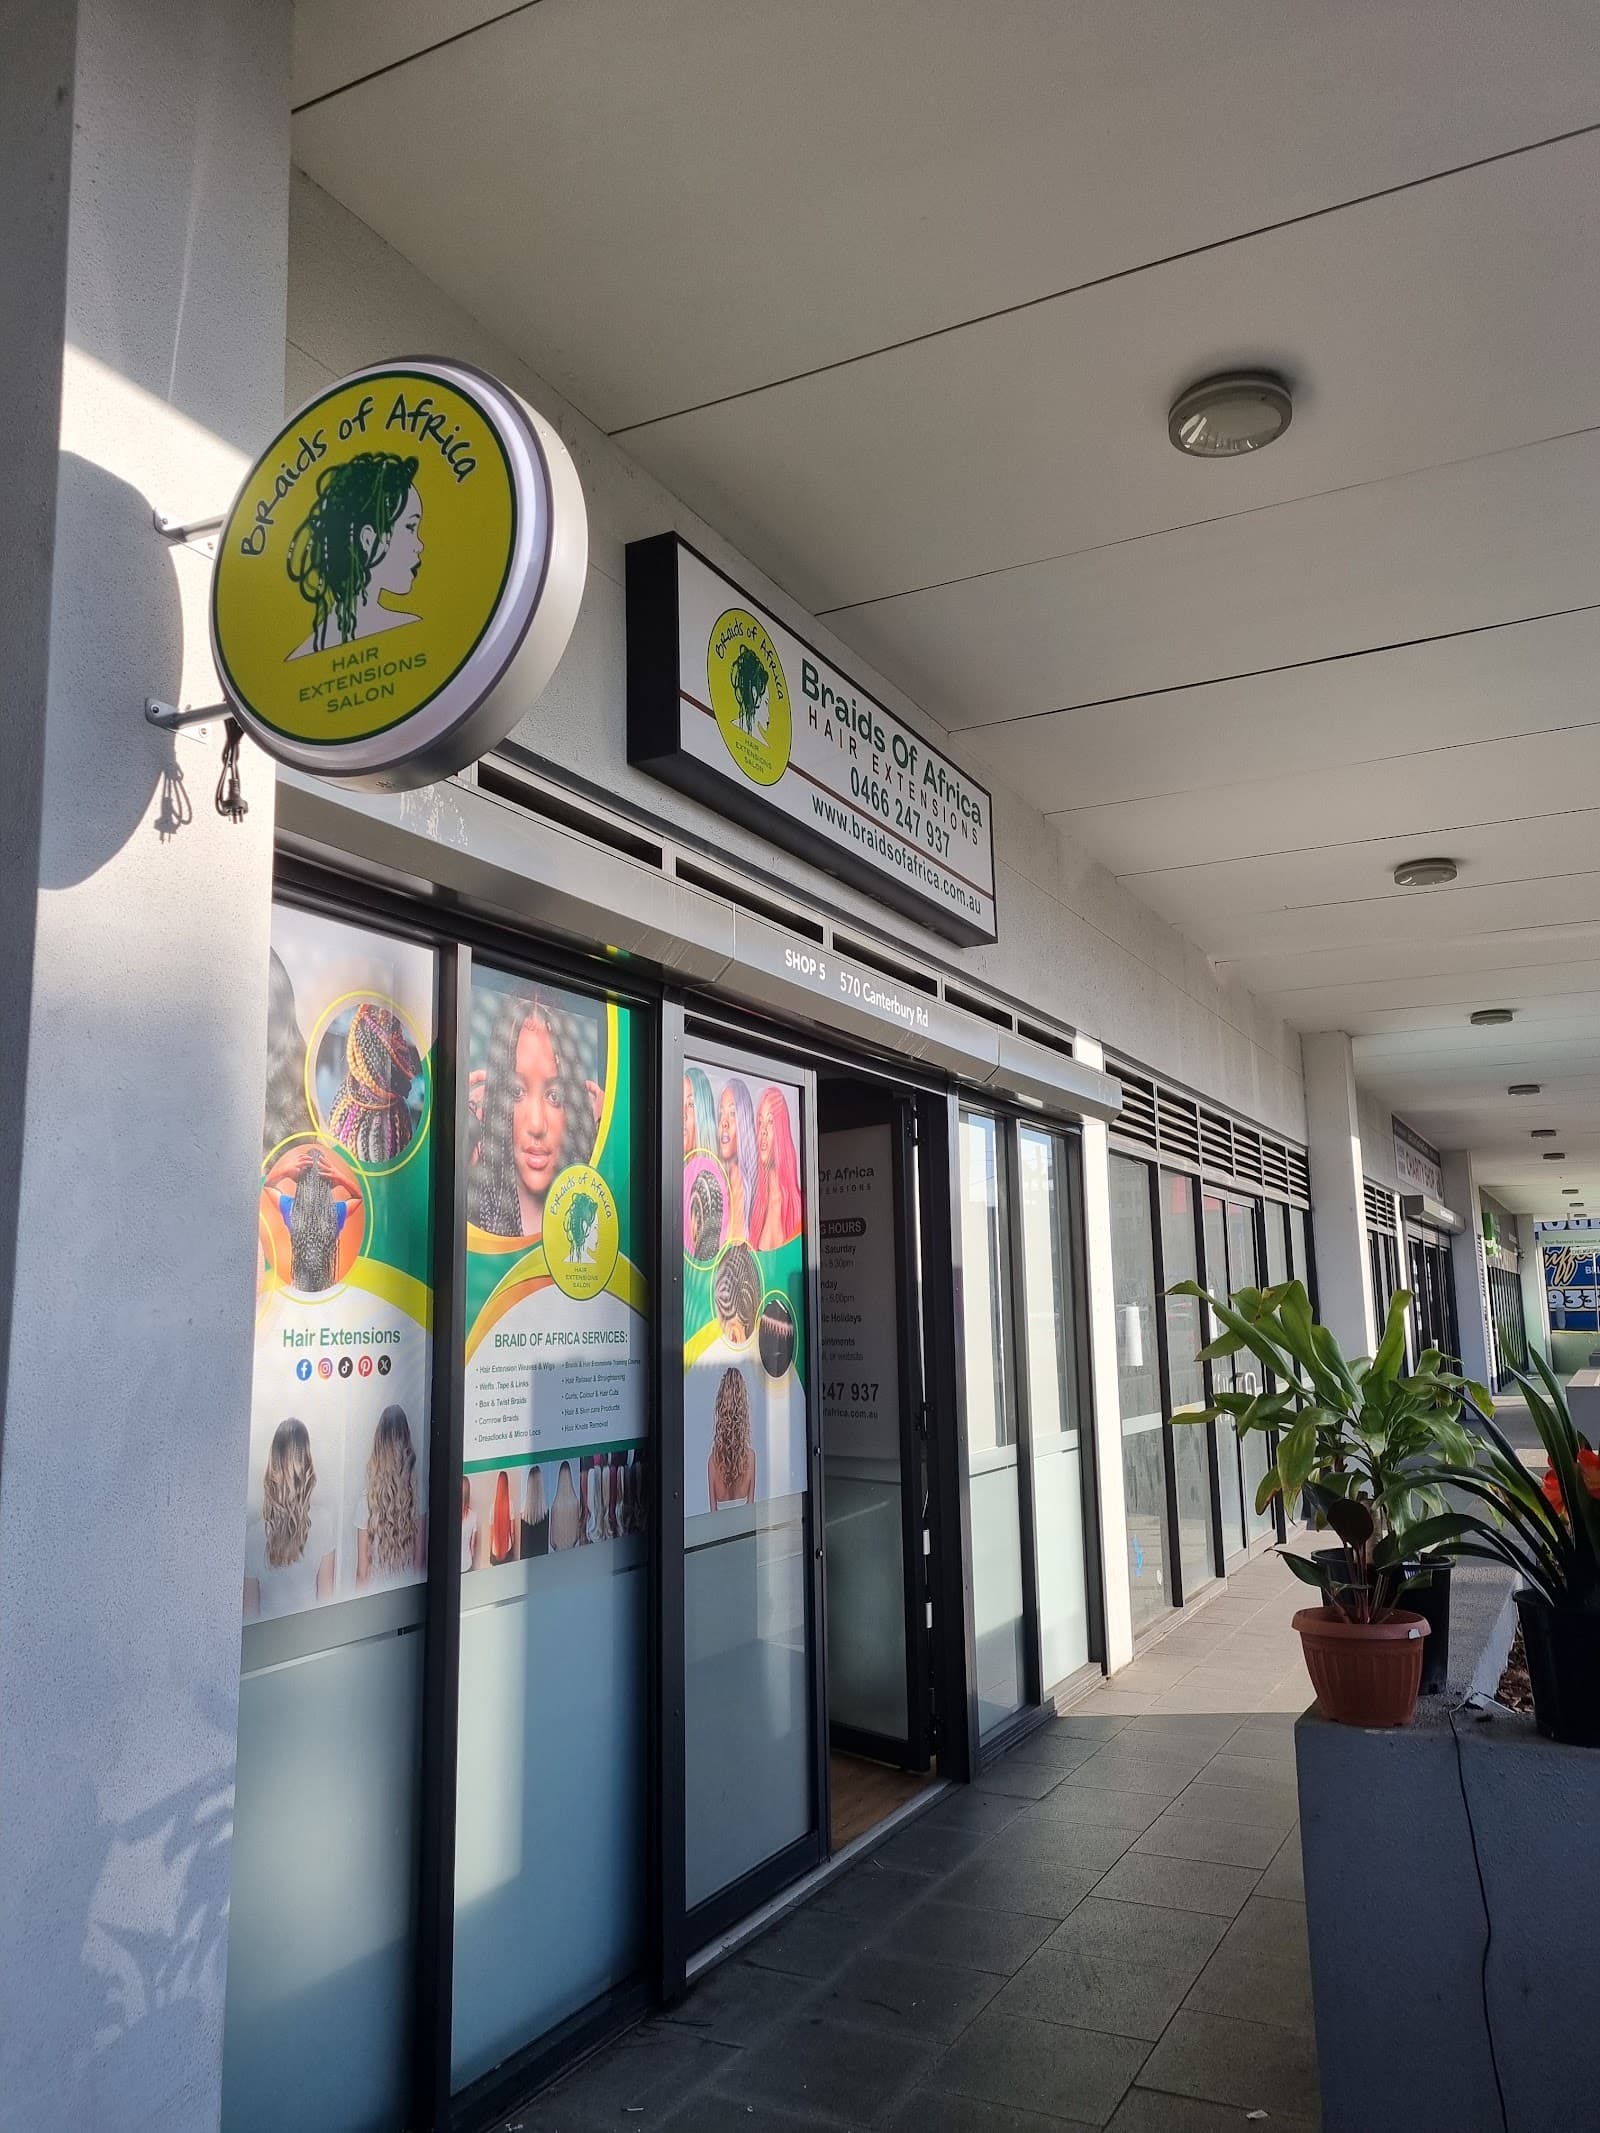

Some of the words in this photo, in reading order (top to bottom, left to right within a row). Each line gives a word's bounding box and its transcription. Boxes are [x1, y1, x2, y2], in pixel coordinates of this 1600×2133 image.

[338, 396, 374, 441] of
[746, 626, 758, 641] of
[332, 646, 379, 672] HAIR
[299, 652, 428, 702] EXTENSIONS
[327, 683, 395, 713] SALON
[745, 739, 760, 752] HAIR
[801, 658, 886, 753] Braids
[892, 734, 918, 775] Of
[924, 760, 983, 828] Africa
[735, 741, 773, 770] EXTENSIONS
[744, 756, 764, 774] SALON
[808, 705, 858, 760] HAIR
[872, 752, 978, 846] EXTENSIONS
[850, 766, 890, 818] 0466
[895, 798, 921, 838] 247
[926, 819, 950, 858] 937
[811, 794, 982, 916] www.braidsofafrica.com.au
[785, 948, 817, 976] SHOP
[819, 962, 826, 981] 5
[840, 972, 861, 998] 570
[862, 983, 916, 1026] Canterbury
[916, 1006, 929, 1028] Rd
[578, 1171, 589, 1185] of
[835, 1166, 875, 1181] Africa
[828, 1221, 862, 1234] HOURS
[825, 1244, 857, 1256] Saturday
[831, 1312, 862, 1325] Holidays
[283, 1328, 316, 1348] Hair
[320, 1326, 401, 1347] Extensions
[494, 1333, 527, 1348] BRAID
[529, 1333, 543, 1347] OF
[545, 1331, 580, 1346] AFRICA
[581, 1330, 628, 1345] SERVICES:
[480, 1365, 490, 1374] Hair
[492, 1364, 518, 1373] Extension
[518, 1363, 537, 1371] Weaves
[543, 1361, 555, 1371] Wigs
[515, 1379, 529, 1388] Links
[851, 1382, 880, 1403] 937
[479, 1400, 490, 1408] Box
[497, 1398, 510, 1407] Twist
[511, 1397, 527, 1405] Braids
[565, 1408, 574, 1416] Hair
[601, 1404, 620, 1412] Products
[478, 1417, 501, 1425] Cornrow
[502, 1414, 519, 1423] Braids
[565, 1424, 574, 1432] Hair
[589, 1420, 609, 1429] Removal
[478, 1432, 508, 1443] Dreadlocks
[514, 1430, 528, 1438] Micro
[529, 1428, 542, 1436] Locs
